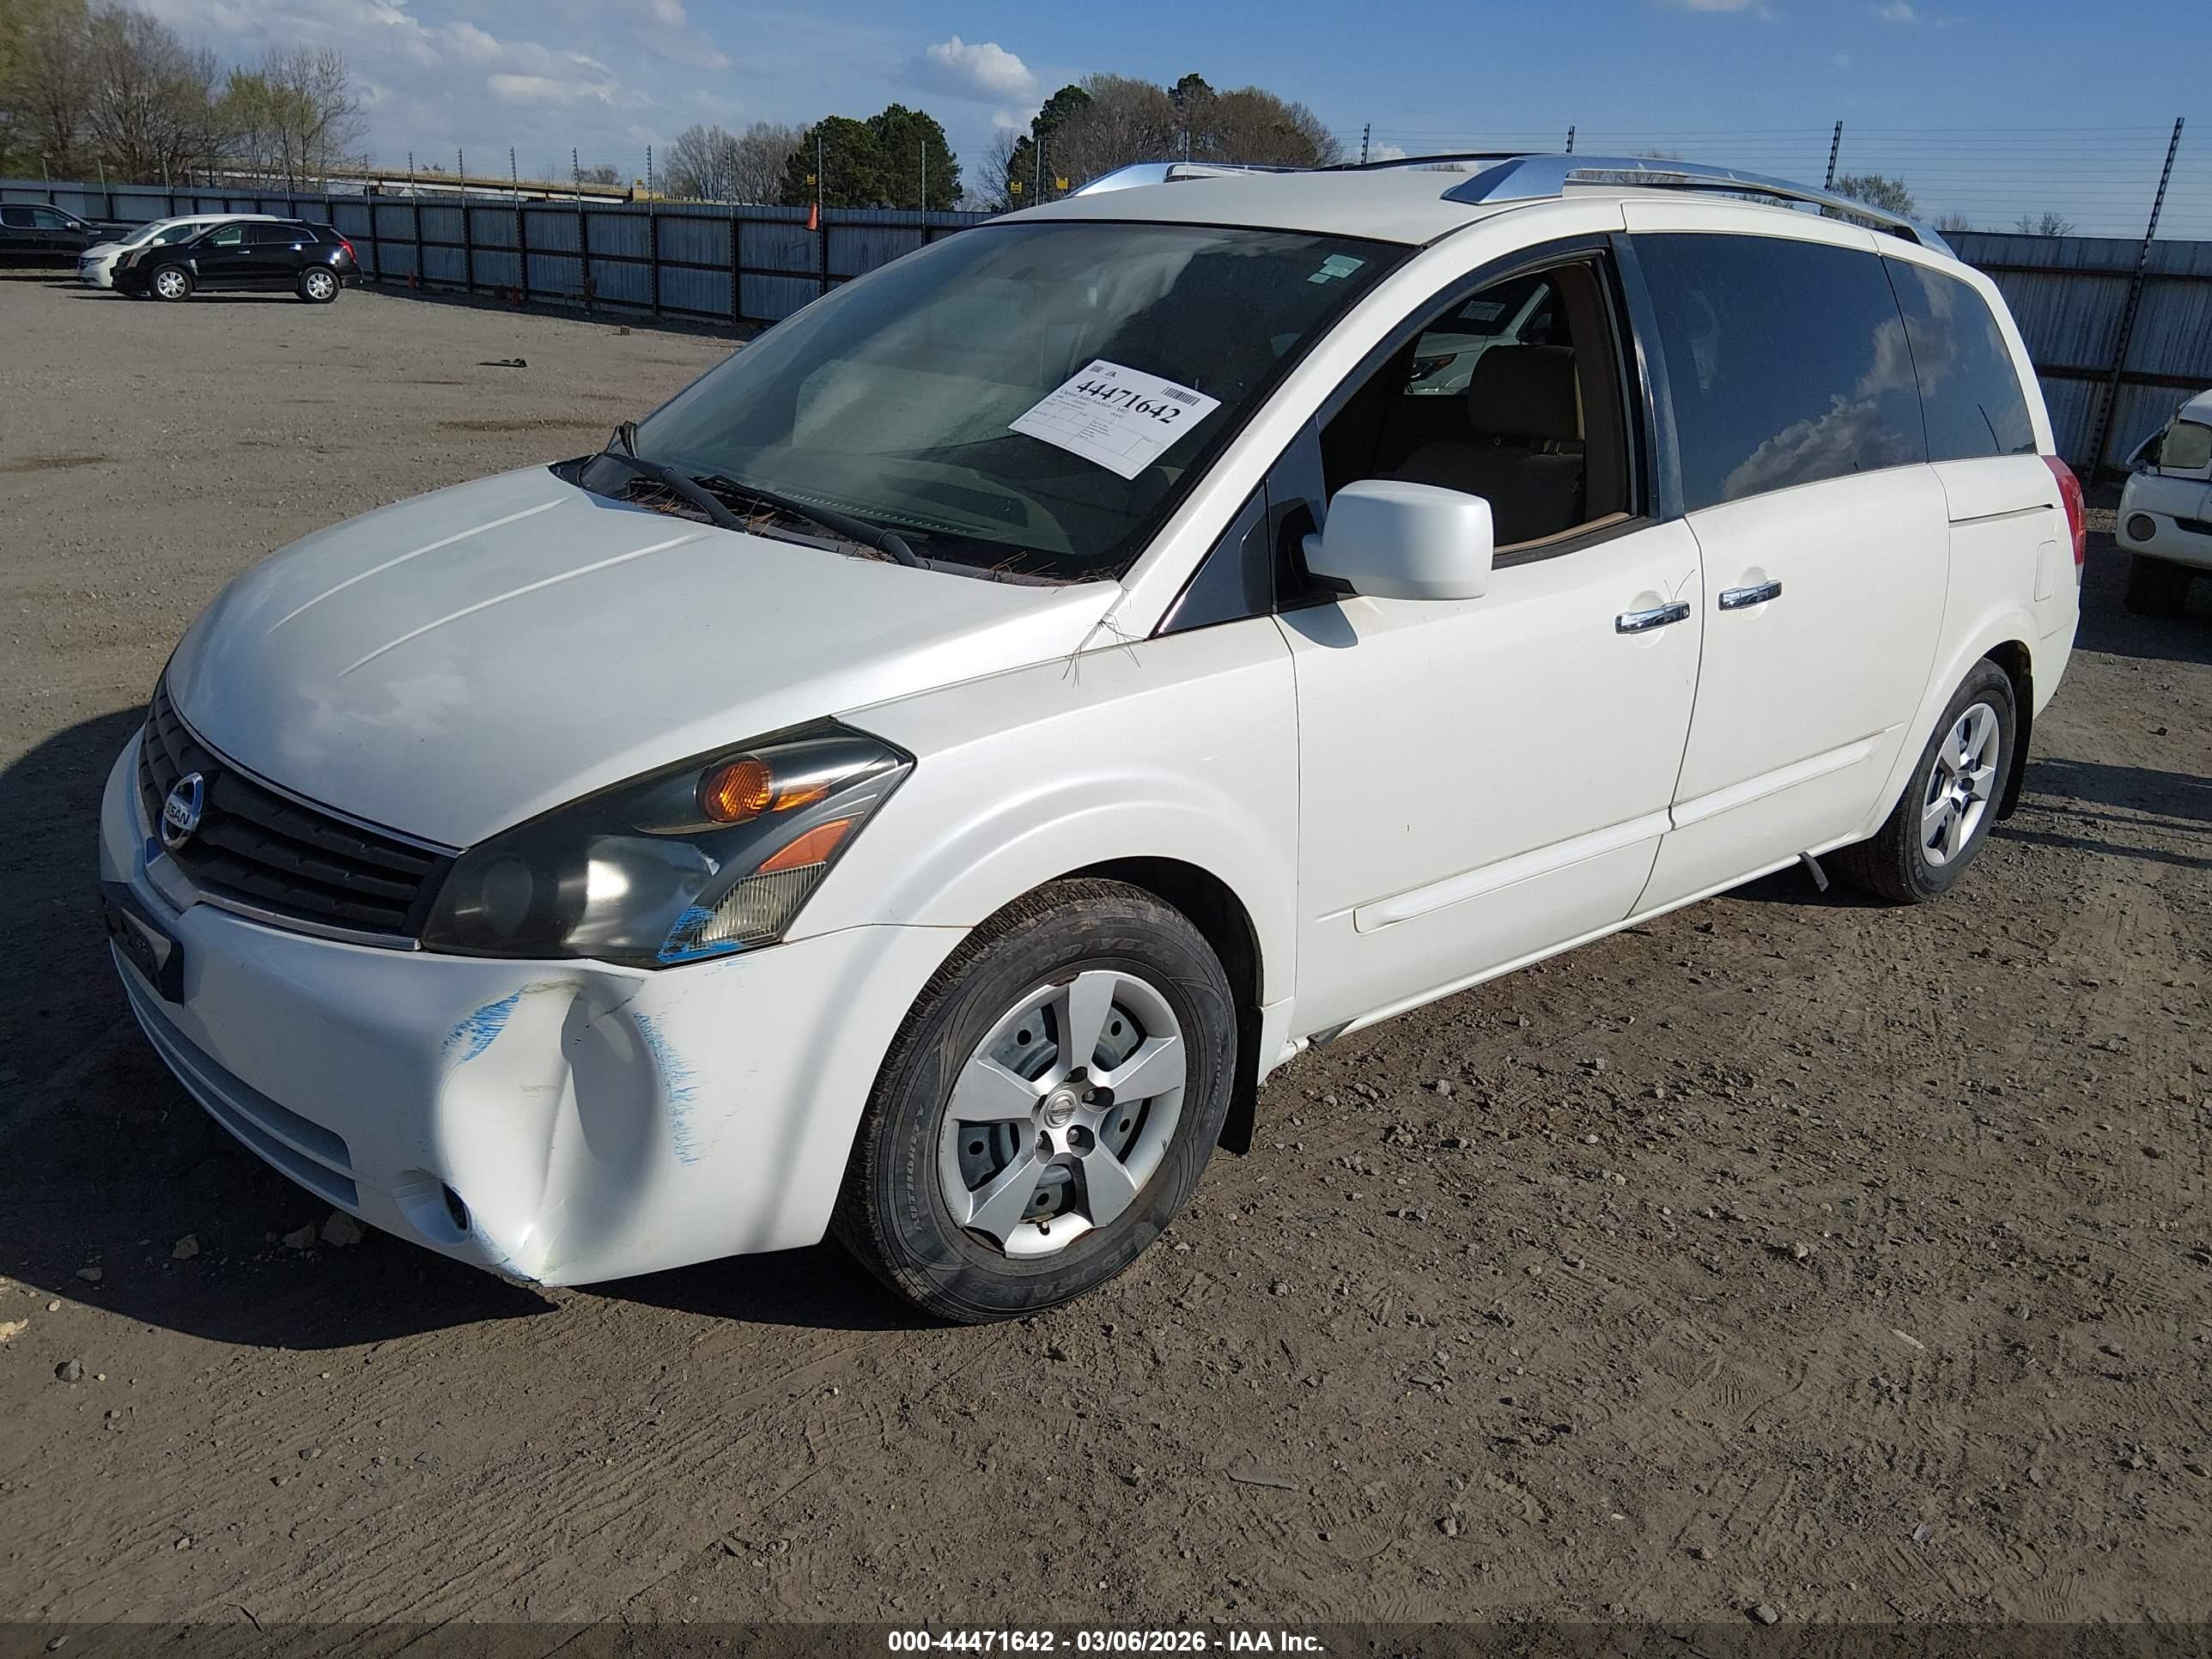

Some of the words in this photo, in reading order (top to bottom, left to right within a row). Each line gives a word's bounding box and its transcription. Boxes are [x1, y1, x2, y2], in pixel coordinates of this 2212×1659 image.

[1076, 380, 1182, 424] 44471642
[166, 802, 191, 825] SSAN
[906, 1103, 925, 1231] AUTHORITY
